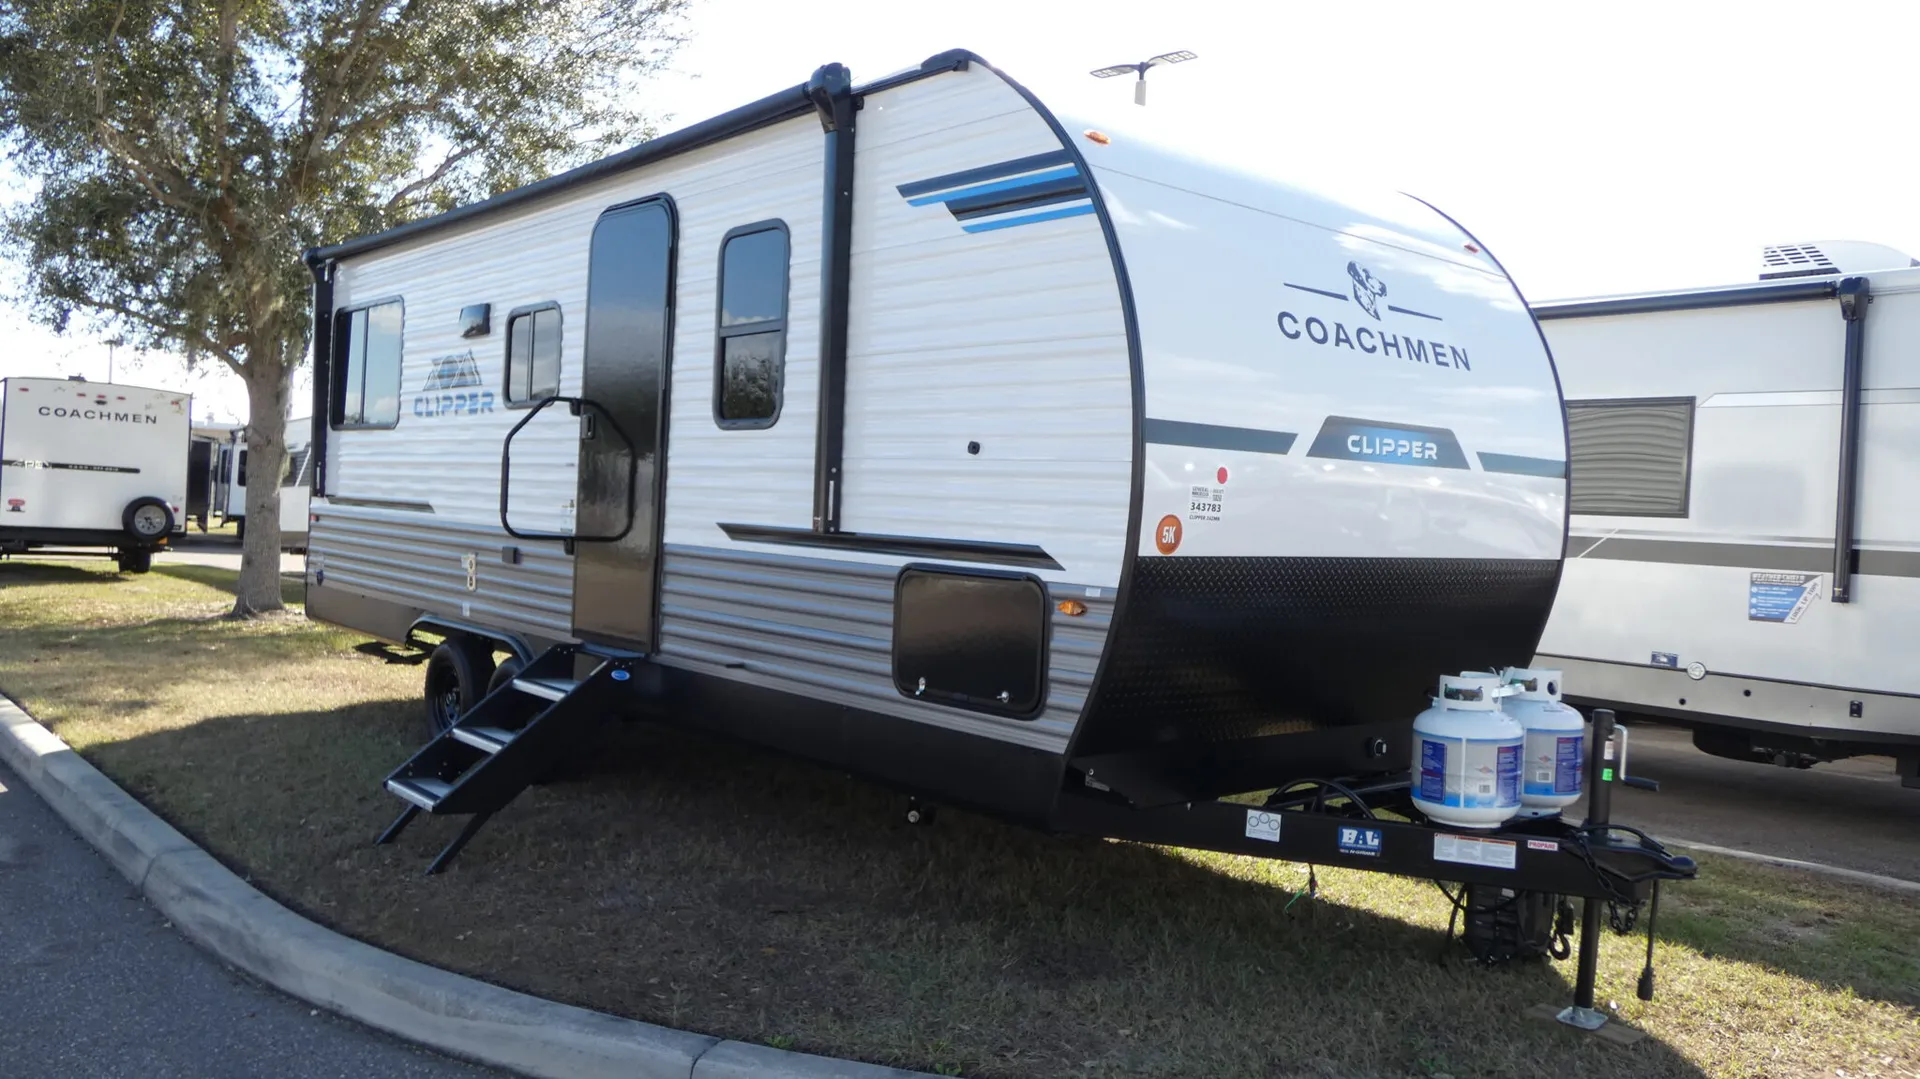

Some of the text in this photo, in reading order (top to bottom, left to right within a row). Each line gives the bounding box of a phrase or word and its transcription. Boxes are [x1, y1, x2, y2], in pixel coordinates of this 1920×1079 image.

[1277, 310, 1471, 372] COACHMEN
[414, 391, 494, 417] CLIPPER
[38, 406, 157, 424] COACHMEN
[1347, 434, 1438, 461] CLIPPER
[1190, 502, 1222, 513] 343783
[1162, 526, 1177, 544] 5K
[1341, 828, 1380, 846] BAL
